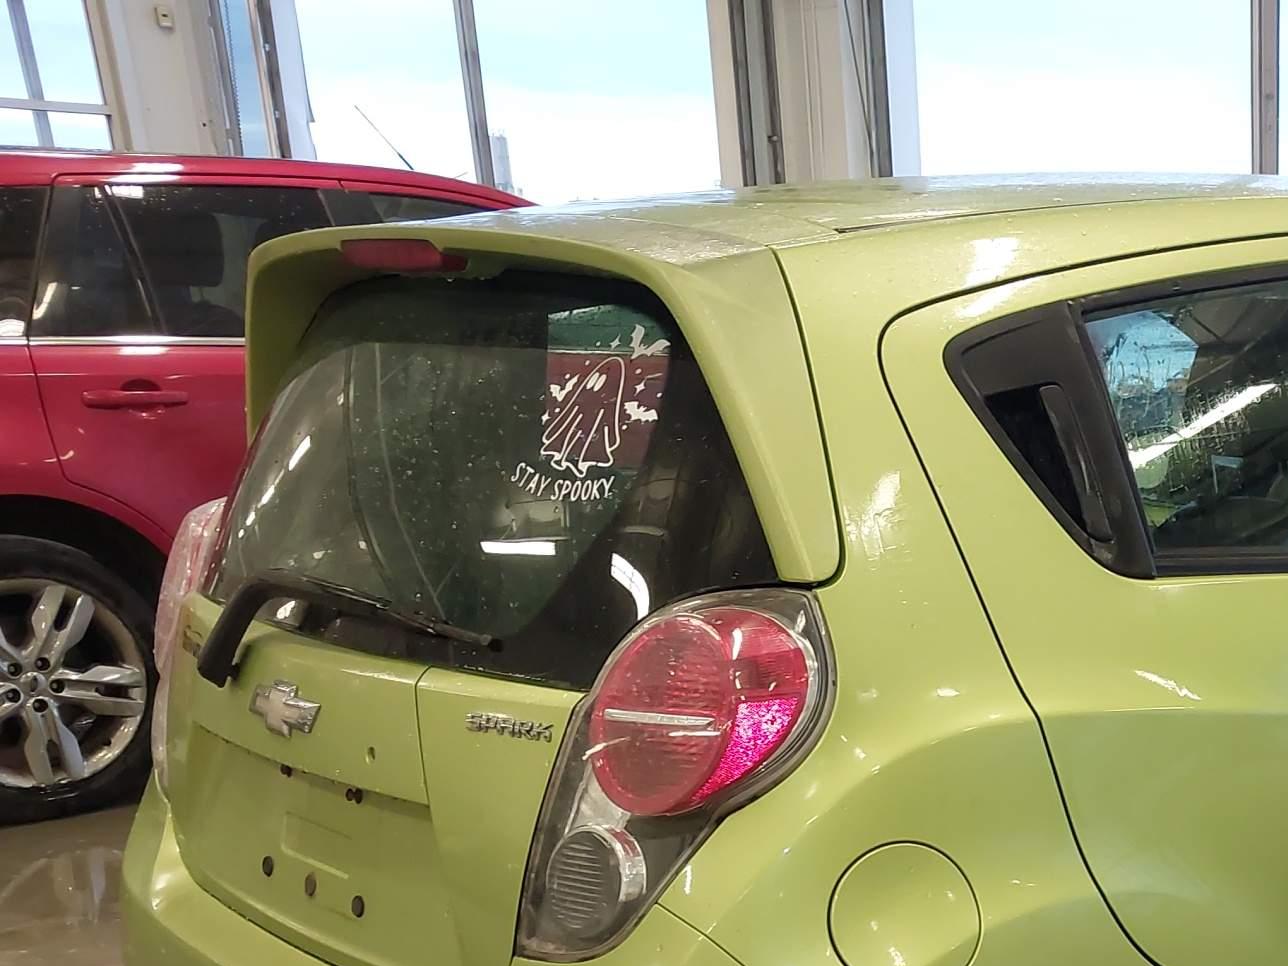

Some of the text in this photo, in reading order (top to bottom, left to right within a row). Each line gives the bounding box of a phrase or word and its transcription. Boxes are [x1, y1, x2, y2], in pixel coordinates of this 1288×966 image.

[511, 462, 615, 501] STAY SPOOKY
[465, 712, 554, 743] SPARK
